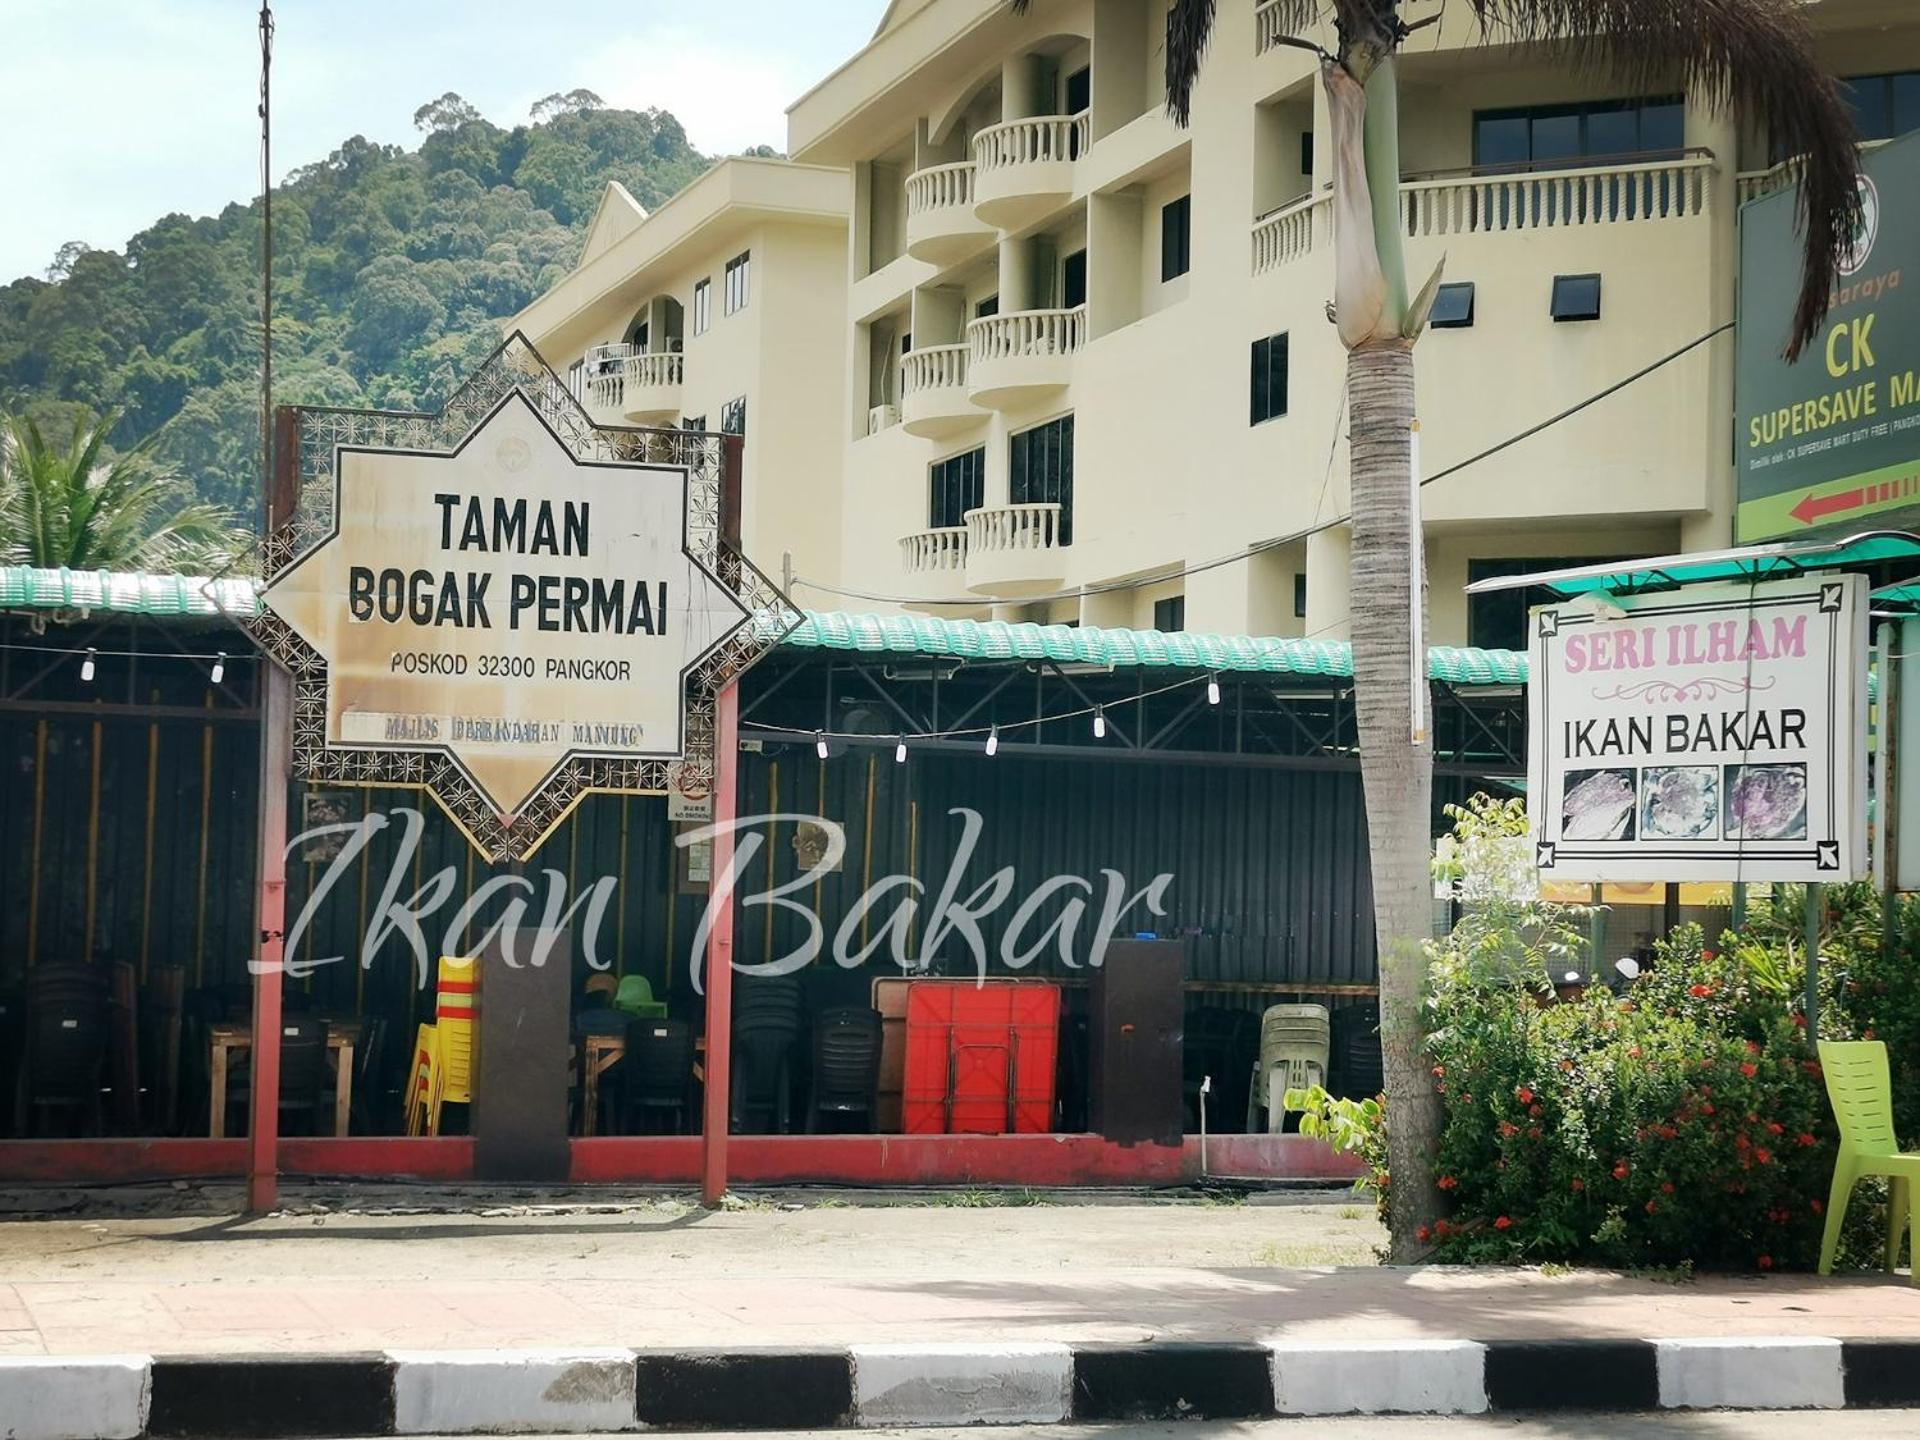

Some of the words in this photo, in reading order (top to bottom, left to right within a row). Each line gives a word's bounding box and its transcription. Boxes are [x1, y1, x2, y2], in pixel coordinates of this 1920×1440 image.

[1828, 269, 1901, 309] saraya
[1825, 313, 1876, 377] CK
[1750, 382, 1877, 448] SUPERSAVE
[1871, 422, 1888, 437] FREE
[434, 493, 590, 557] TAMAN
[348, 566, 492, 629] BOGAK
[510, 574, 668, 636] PERMAI
[391, 652, 468, 675] POSKOD
[478, 655, 535, 679] 32300
[546, 658, 631, 682] PANGKOR
[1564, 627, 1656, 674] SERI
[1666, 614, 1807, 666] ILHAM
[1563, 715, 1653, 759] IKAN
[1665, 708, 1807, 754] BAKAR
